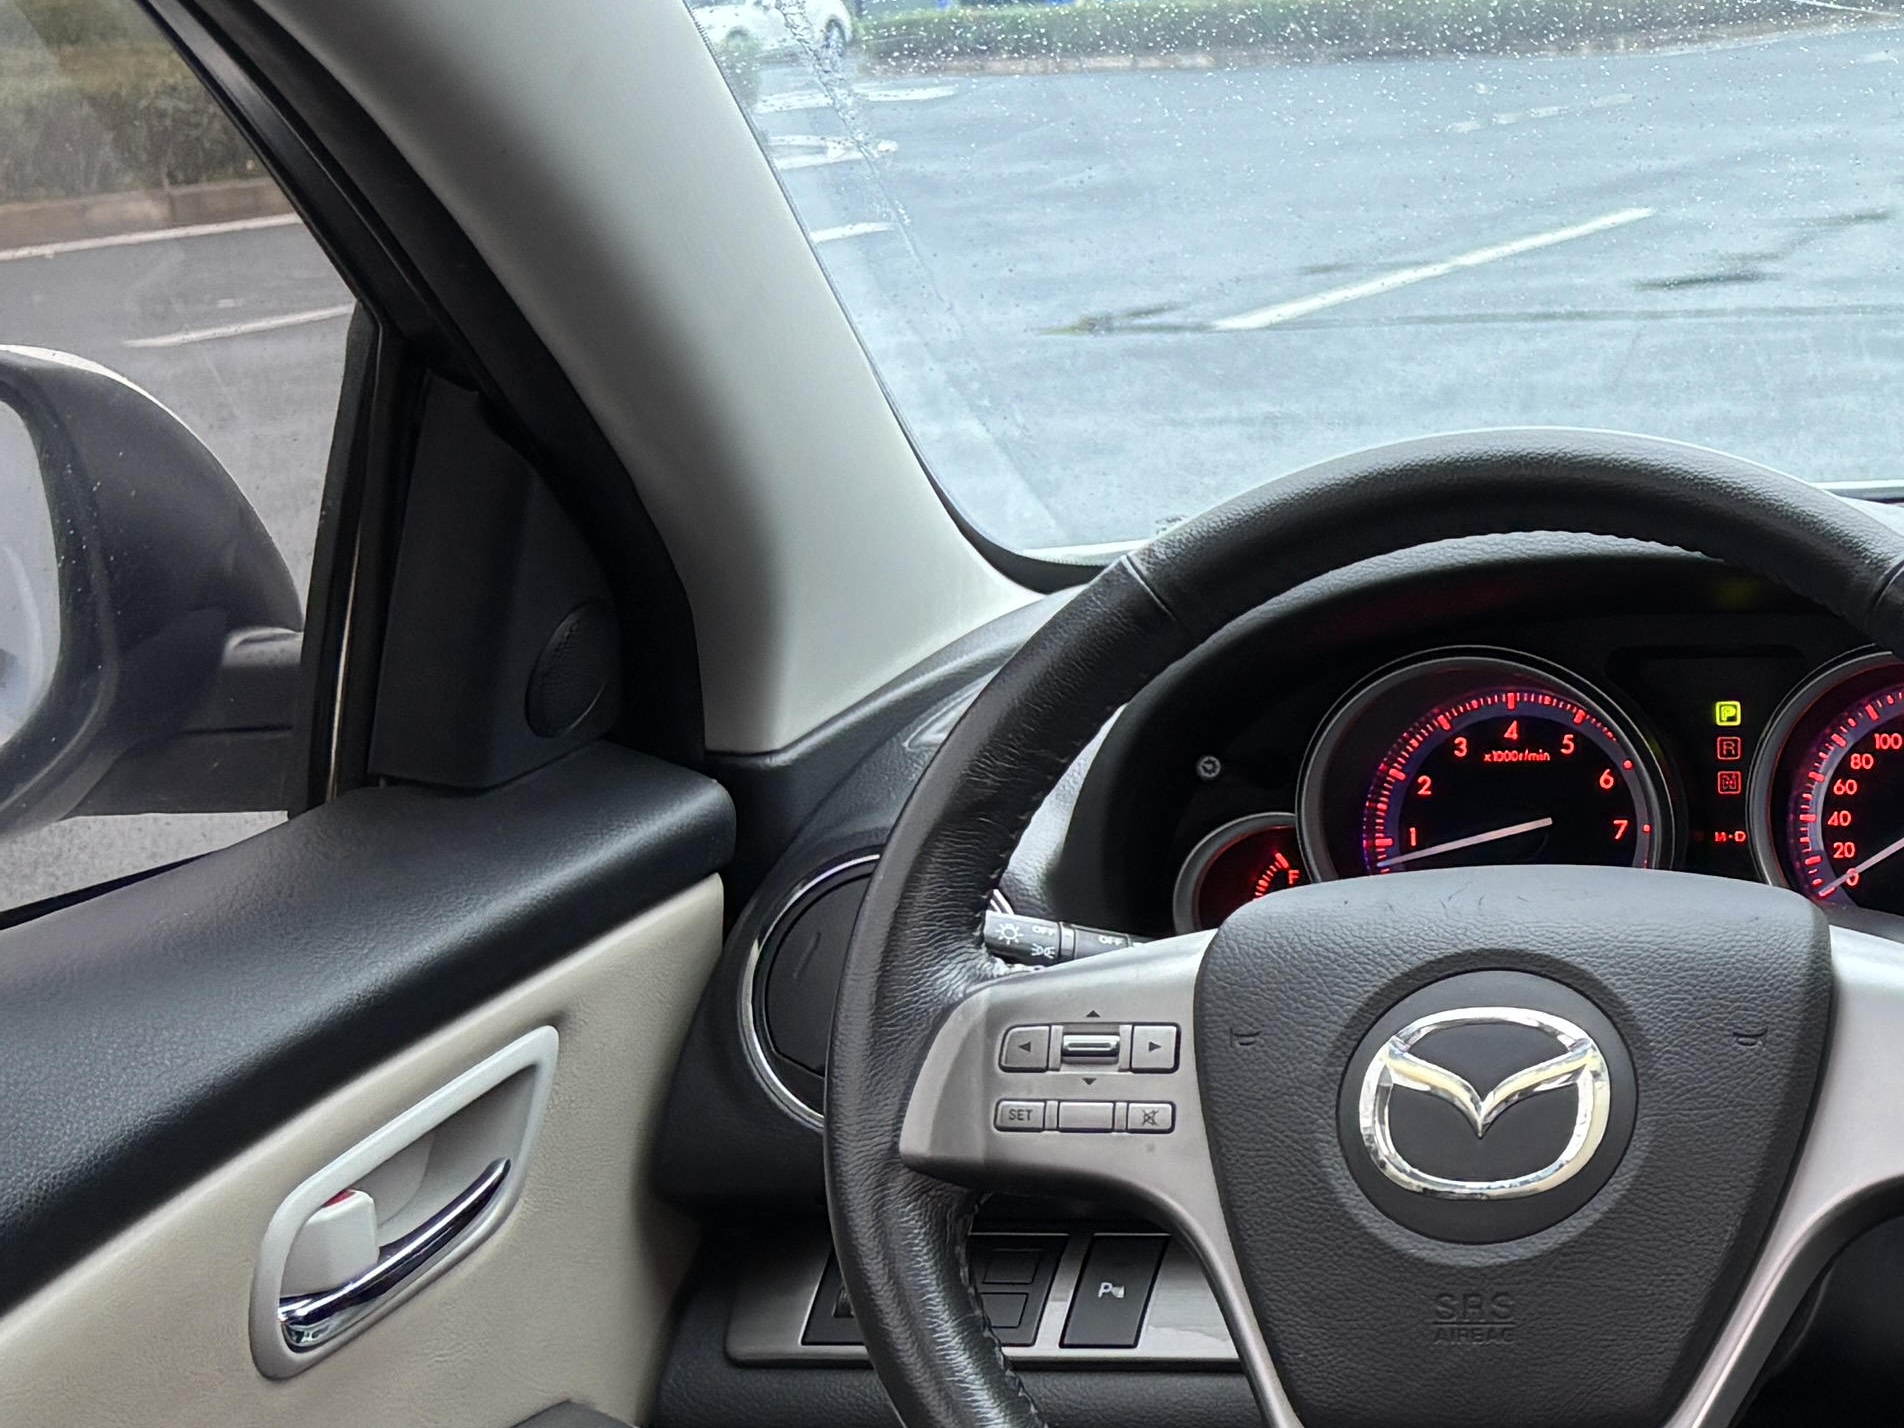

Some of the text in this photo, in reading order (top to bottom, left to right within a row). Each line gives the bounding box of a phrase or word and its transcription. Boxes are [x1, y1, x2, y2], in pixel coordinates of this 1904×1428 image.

[1720, 705, 1736, 722] P
[1503, 720, 1518, 740] 4
[1454, 737, 1468, 757] 3
[1560, 734, 1575, 754] 5
[1722, 740, 1735, 755] R
[1874, 733, 1903, 750] 100
[1850, 753, 1874, 770] 80
[1417, 775, 1432, 795] 2
[1599, 768, 1614, 789] 6
[1833, 778, 1858, 795] 60
[1827, 810, 1852, 827] 40
[1409, 827, 1416, 846] 1
[1613, 819, 1628, 839] 7
[1833, 841, 1856, 859] 20
[1288, 869, 1299, 884] F
[1845, 868, 1859, 886] 0
[1031, 925, 1055, 936] OFF
[1099, 936, 1125, 946] OFF
[1008, 1109, 1033, 1121] SET
[1436, 1292, 1515, 1322] SRS
